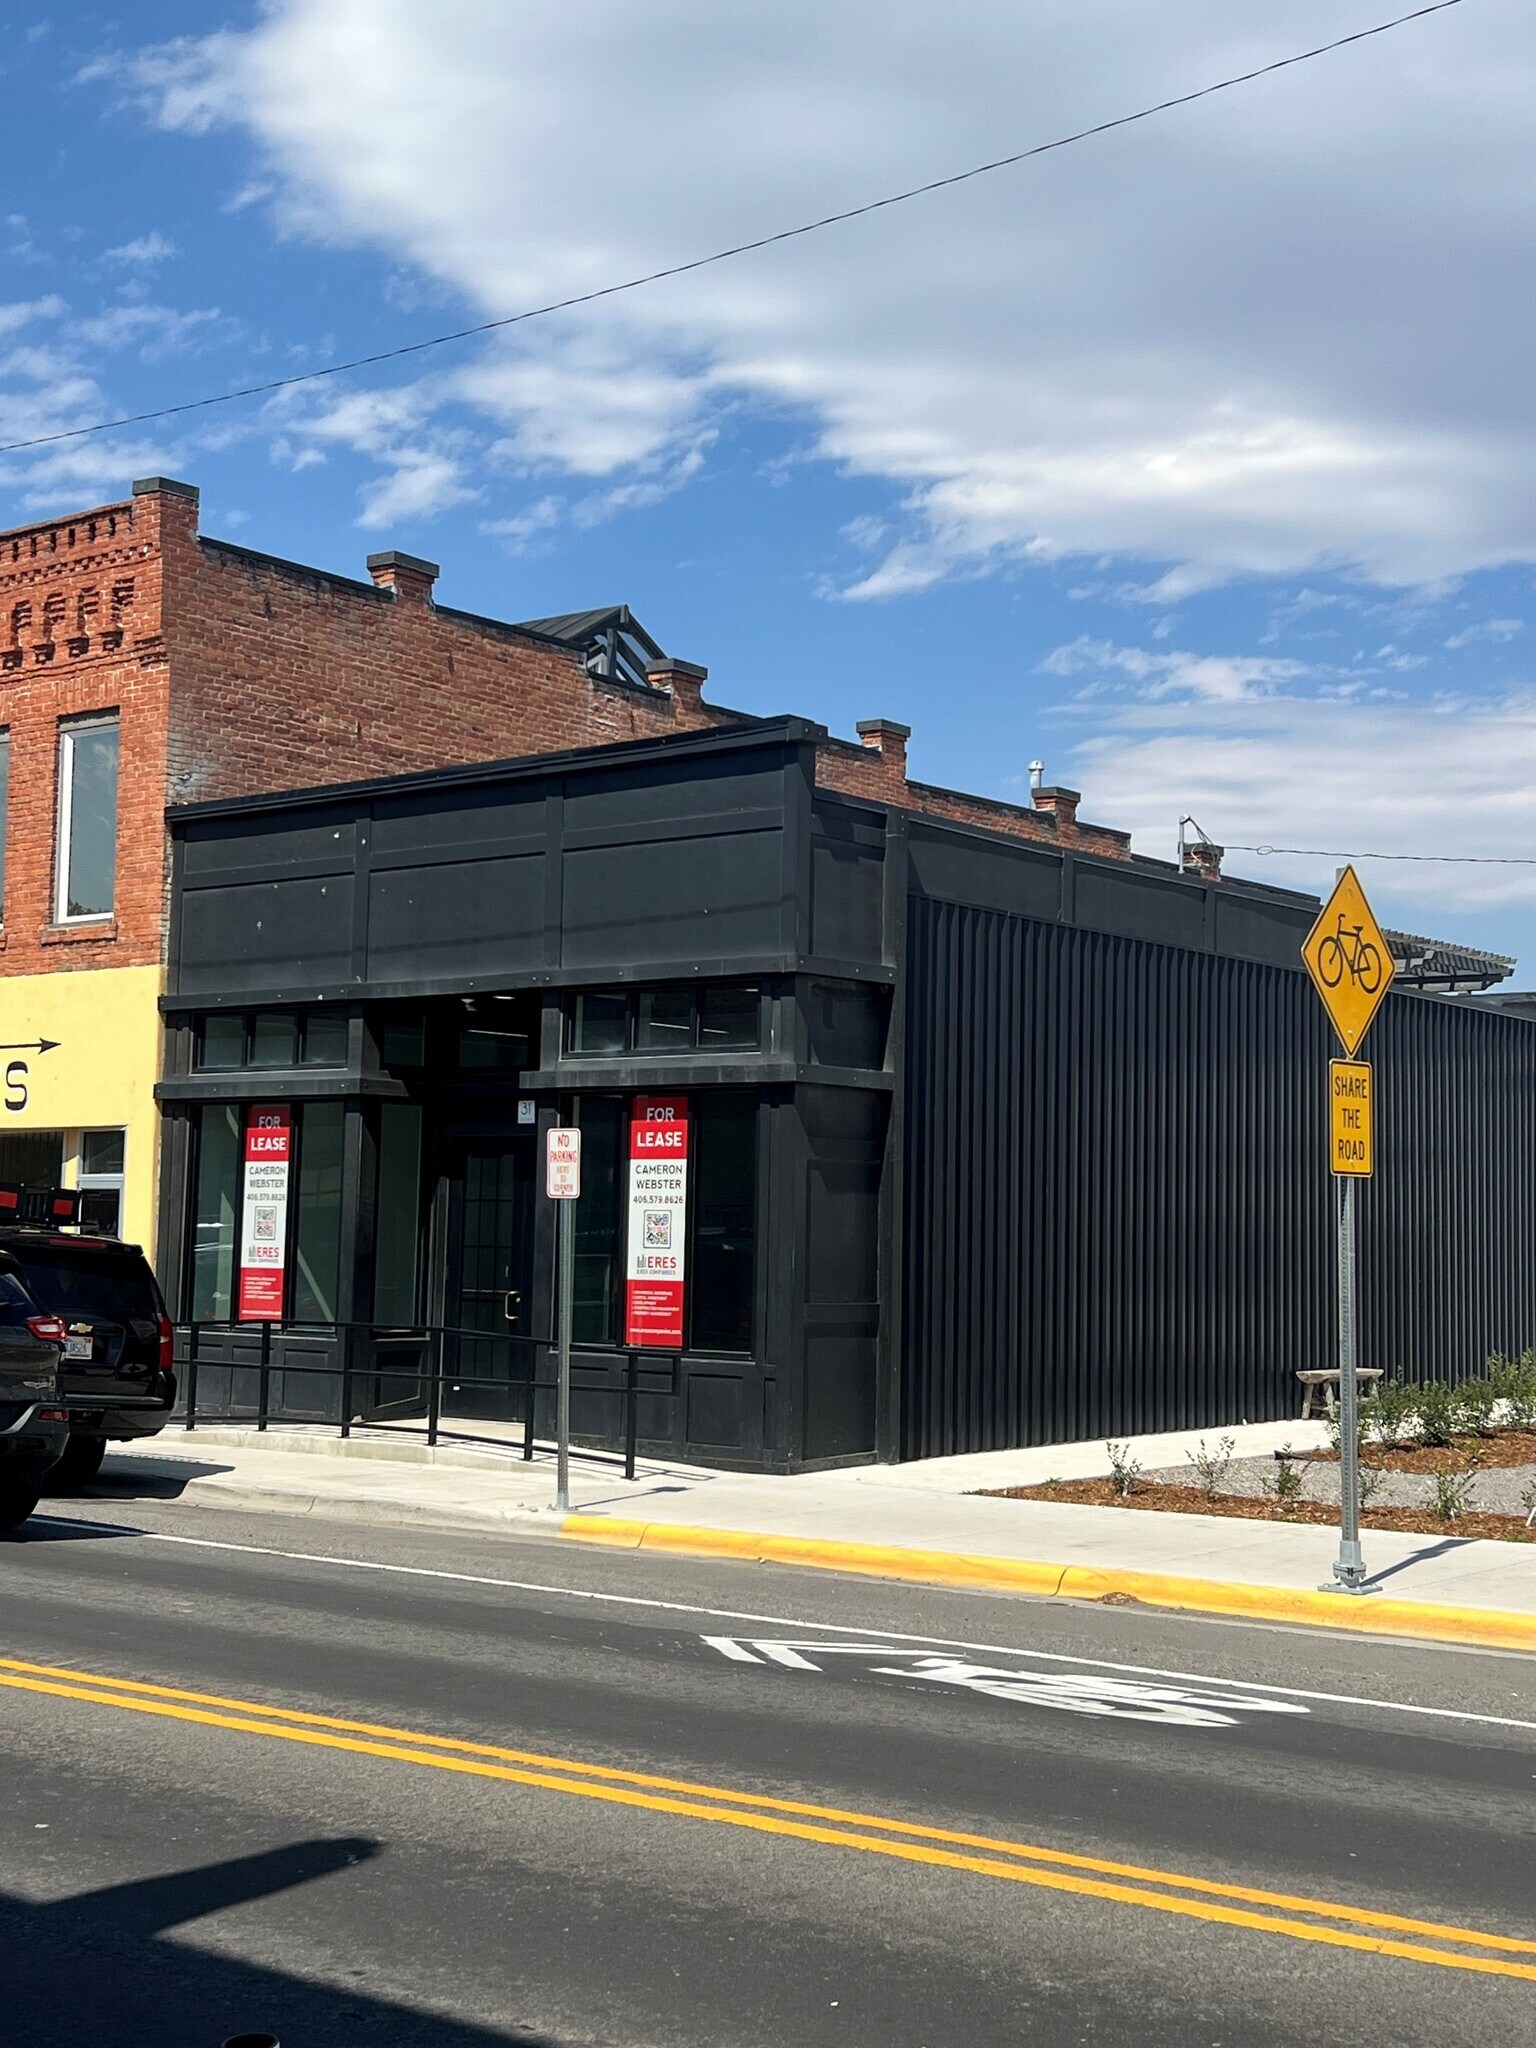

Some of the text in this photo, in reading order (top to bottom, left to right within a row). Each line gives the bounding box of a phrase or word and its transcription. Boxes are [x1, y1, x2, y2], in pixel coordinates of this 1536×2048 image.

[1334, 1075, 1368, 1099] SHARE
[646, 1107, 675, 1123] FOR
[1342, 1108, 1361, 1129] THE
[258, 1115, 281, 1130] FOR
[250, 1137, 287, 1151] LEASE
[557, 1134, 570, 1148] NO
[636, 1131, 683, 1147] LEASE
[1337, 1139, 1365, 1160] ROAD
[550, 1150, 578, 1163] PARKING
[249, 1166, 286, 1175] CAMERON
[635, 1164, 683, 1175] CAMERON
[249, 1179, 285, 1188] WEBSTER
[636, 1179, 682, 1189] WEBSTER
[633, 1195, 684, 1204] 406.579.8626
[257, 1247, 280, 1258] ERES
[647, 1256, 677, 1269] ERES
